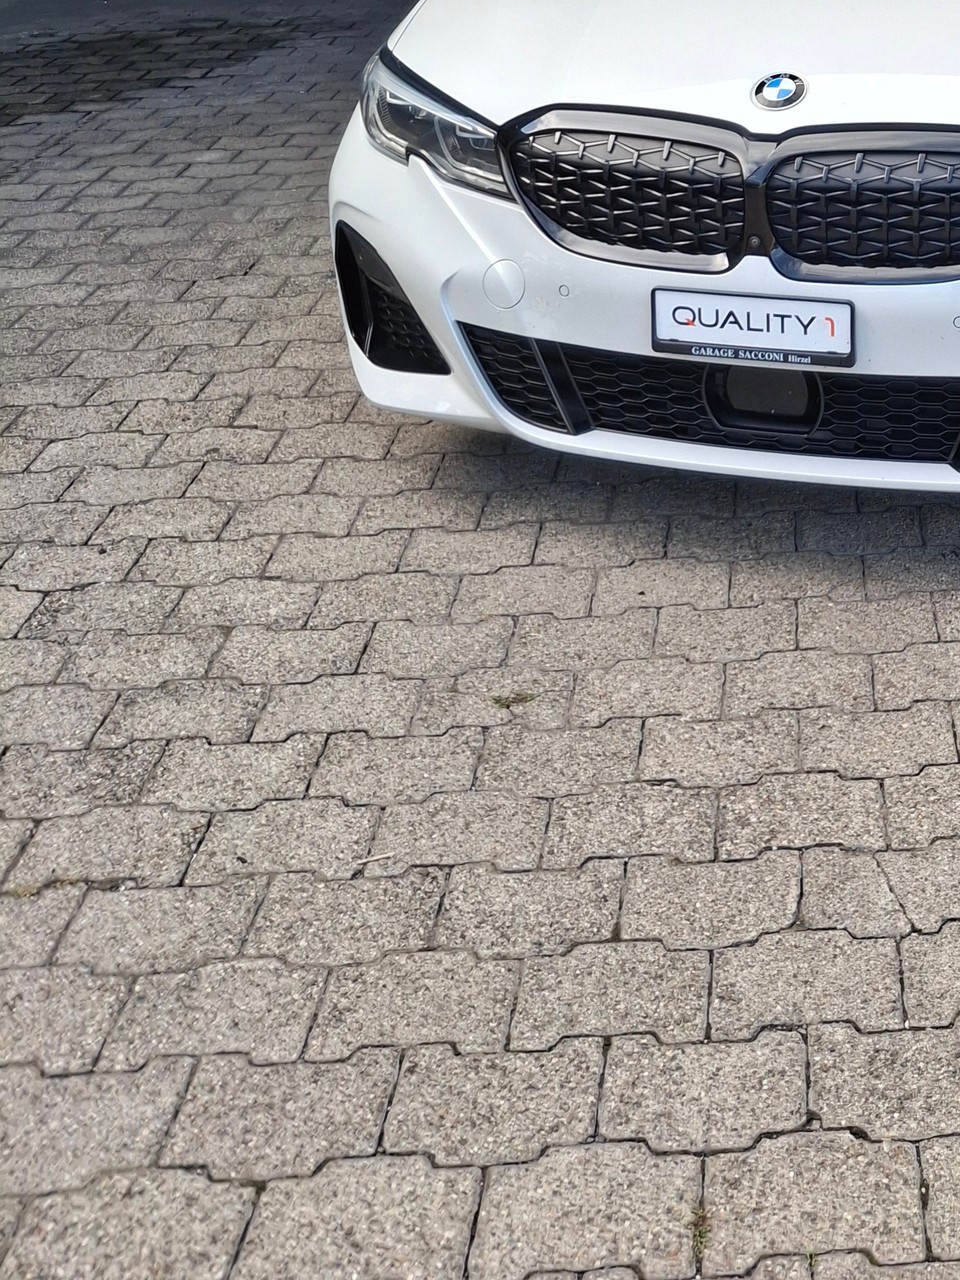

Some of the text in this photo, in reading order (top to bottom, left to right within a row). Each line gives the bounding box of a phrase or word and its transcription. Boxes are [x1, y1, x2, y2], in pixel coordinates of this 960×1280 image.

[691, 346, 811, 364] GARAGE SACCONI Hirzel
